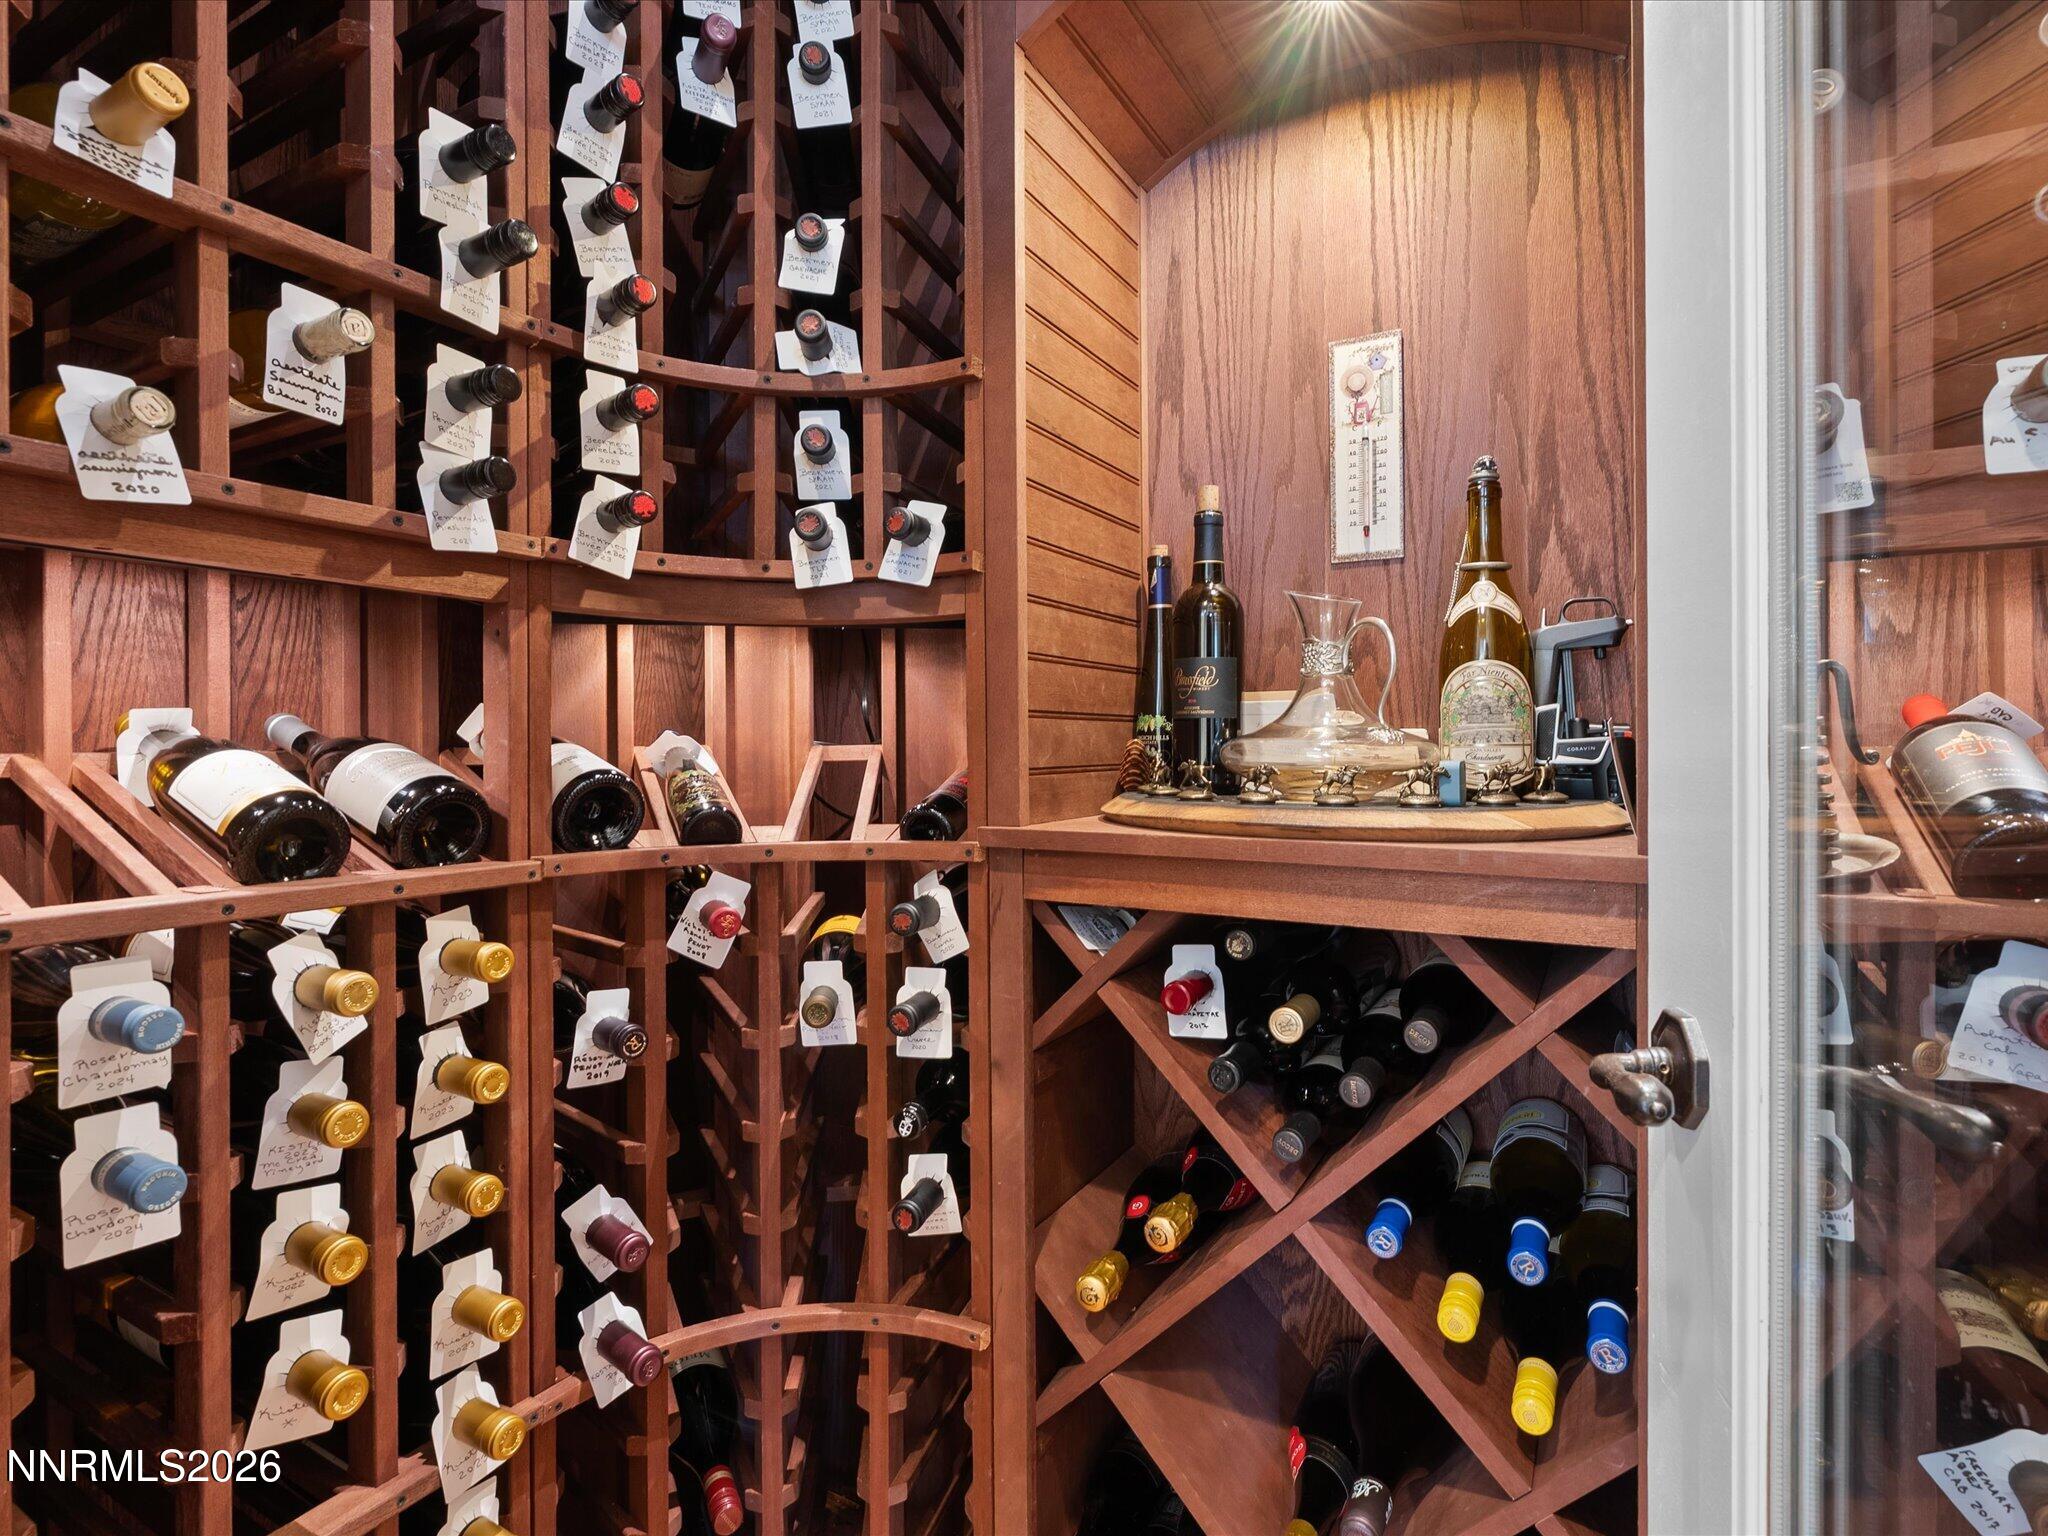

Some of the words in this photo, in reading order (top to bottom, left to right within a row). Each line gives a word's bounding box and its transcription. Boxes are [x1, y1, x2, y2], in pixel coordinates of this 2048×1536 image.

[315, 402, 338, 418] 2020
[111, 481, 160, 494] 2020
[1460, 671, 1475, 680] Far
[1481, 667, 1509, 679] Niente
[1567, 744, 1596, 752] CORAVIN
[442, 989, 473, 1007] 2023
[1408, 1028, 1432, 1047] DECOY
[62, 1056, 168, 1087] Chardonnay
[586, 1071, 609, 1080] 2019
[96, 1075, 135, 1091] 2024
[1349, 1079, 1359, 1104] DECOY
[429, 1105, 454, 1121] 2023
[1276, 1136, 1299, 1157] DECOY
[147, 1191, 182, 1212] OREGON
[103, 1223, 144, 1242] 2024
[448, 1341, 475, 1357] 2023
[1946, 1452, 1983, 1490] ABBEY
[1960, 1450, 2015, 1513] FREEMARK
[1944, 1468, 1968, 1494] CAB
[1970, 1501, 2000, 1530] 2017
